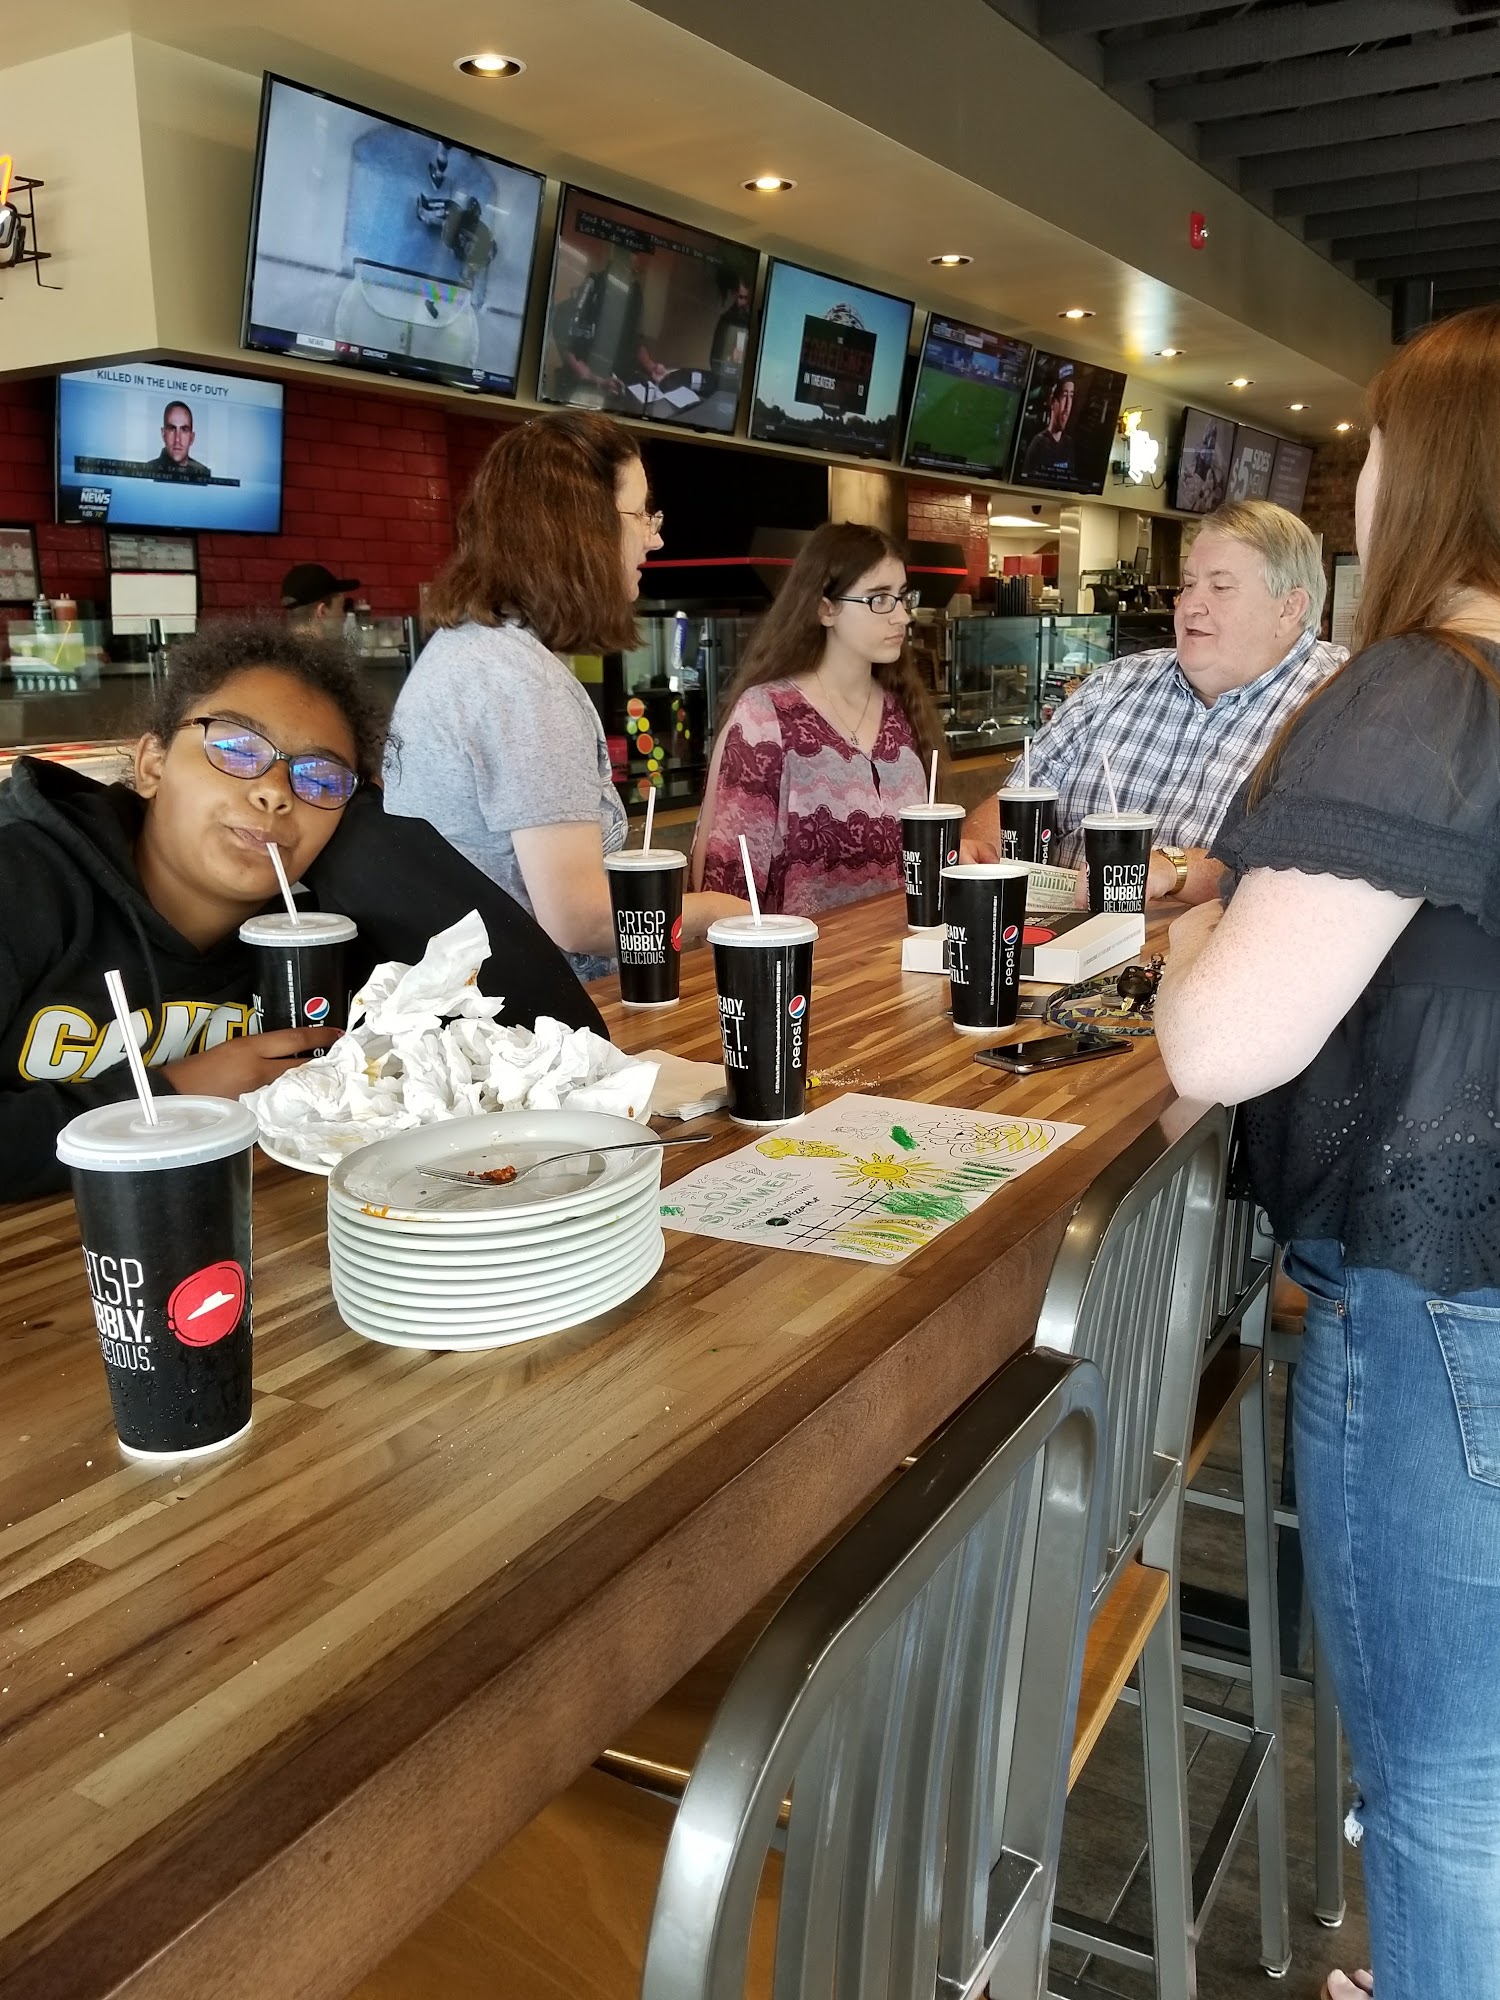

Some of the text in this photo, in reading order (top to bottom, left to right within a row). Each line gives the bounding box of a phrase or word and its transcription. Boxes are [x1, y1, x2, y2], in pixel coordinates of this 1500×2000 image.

[307, 337, 324, 348] NEWS
[97, 370, 230, 397] KILLED IN THE LINE OF DUTY
[811, 373, 836, 390] THEATERS
[81, 493, 111, 505] NEWS
[1001, 829, 1019, 841] EADY.
[1103, 864, 1146, 886] CRISP.
[1103, 885, 1143, 901] BUBBLY.
[617, 910, 666, 934] CRISP.
[946, 925, 968, 941] EADY.
[619, 934, 666, 951] BUBBLY.
[621, 950, 666, 965] DELICIOUS.
[1004, 945, 1015, 986] pepsi
[718, 994, 746, 1017] EADY.
[18, 1002, 262, 1083] CANT
[791, 1018, 803, 1069] pepsi
[723, 1048, 749, 1070] HILL.
[688, 1174, 756, 1209] LOVE
[699, 1171, 801, 1224] SUMMER
[783, 1195, 820, 1221] Pizza Hut
[732, 1216, 757, 1231] FROM
[92, 1296, 152, 1343] BBLY.
